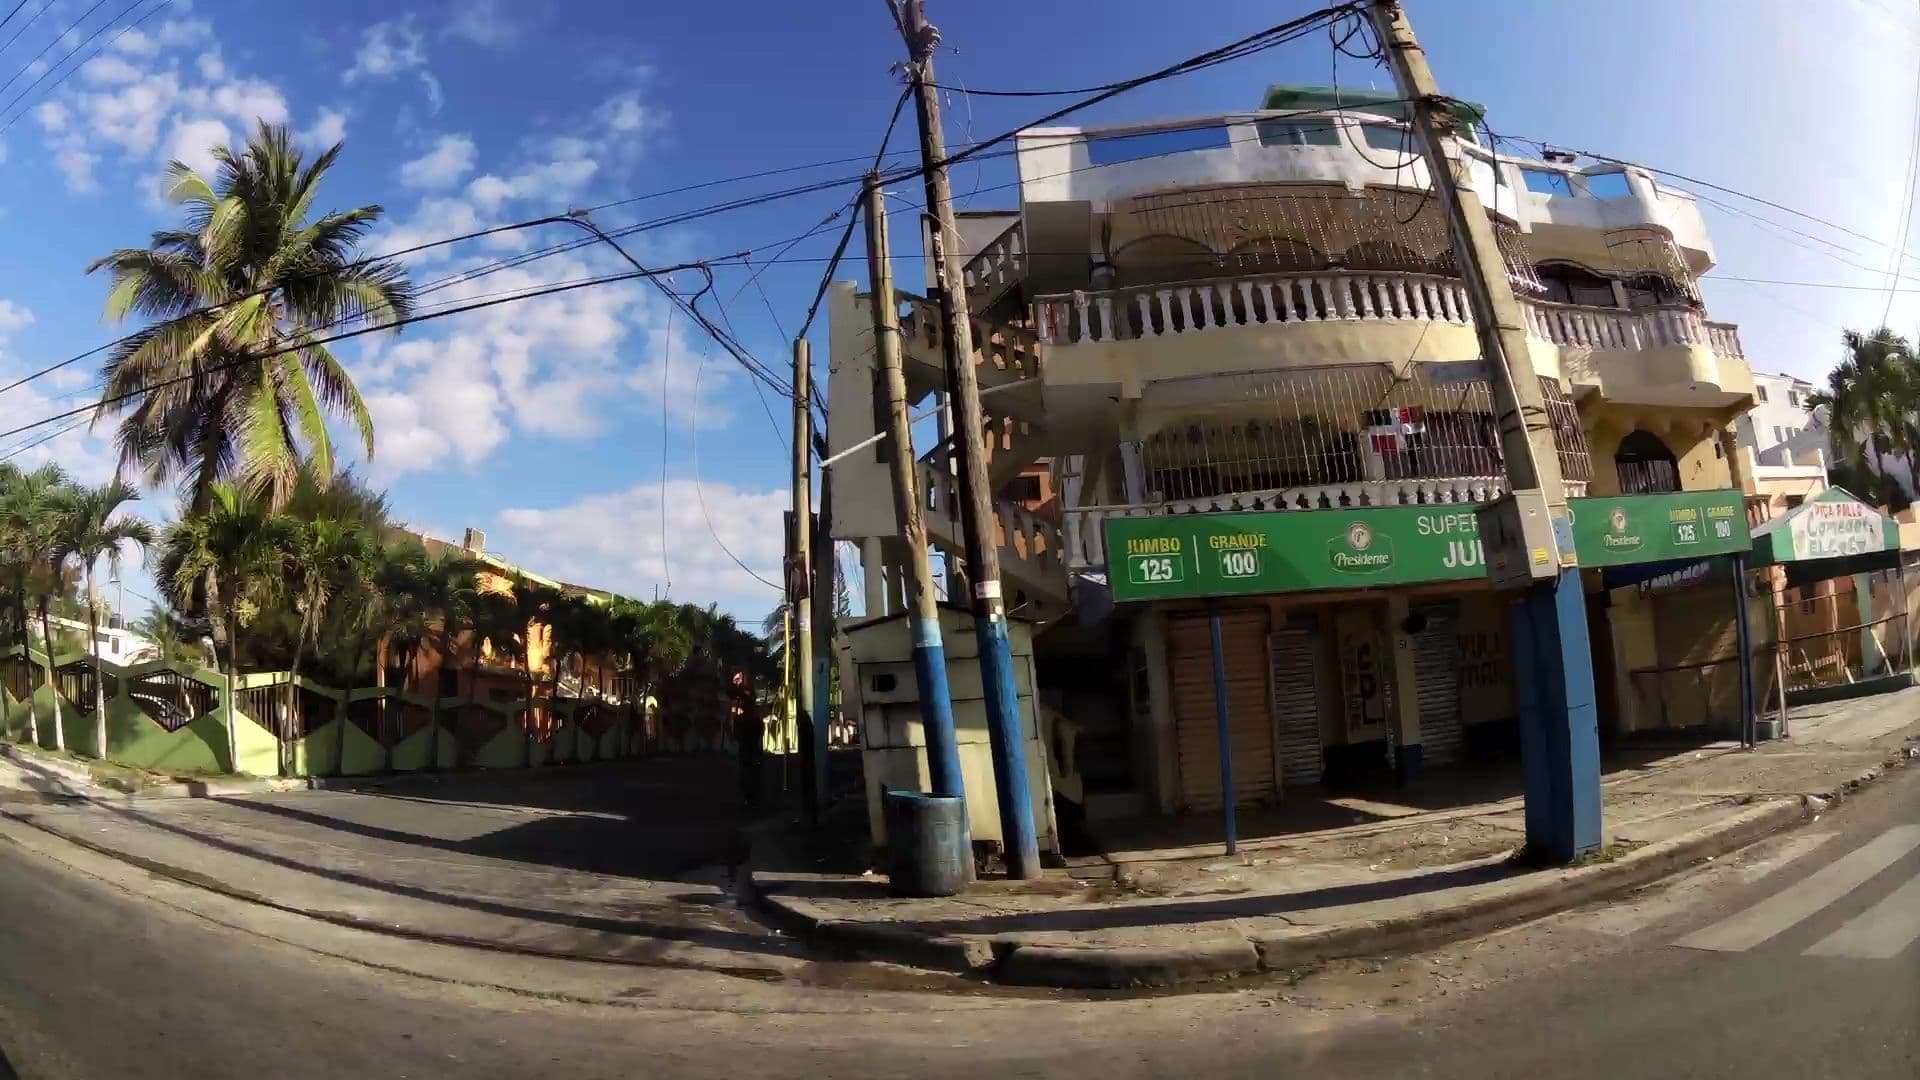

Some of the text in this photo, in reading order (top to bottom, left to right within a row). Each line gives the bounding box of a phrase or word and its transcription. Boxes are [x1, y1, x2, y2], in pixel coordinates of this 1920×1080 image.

[1127, 537, 1180, 554] JUMBO
[1209, 533, 1266, 549] GRANDE
[1223, 552, 1257, 575] 100
[1334, 551, 1389, 567] Presidente
[1140, 559, 1173, 580] 125
